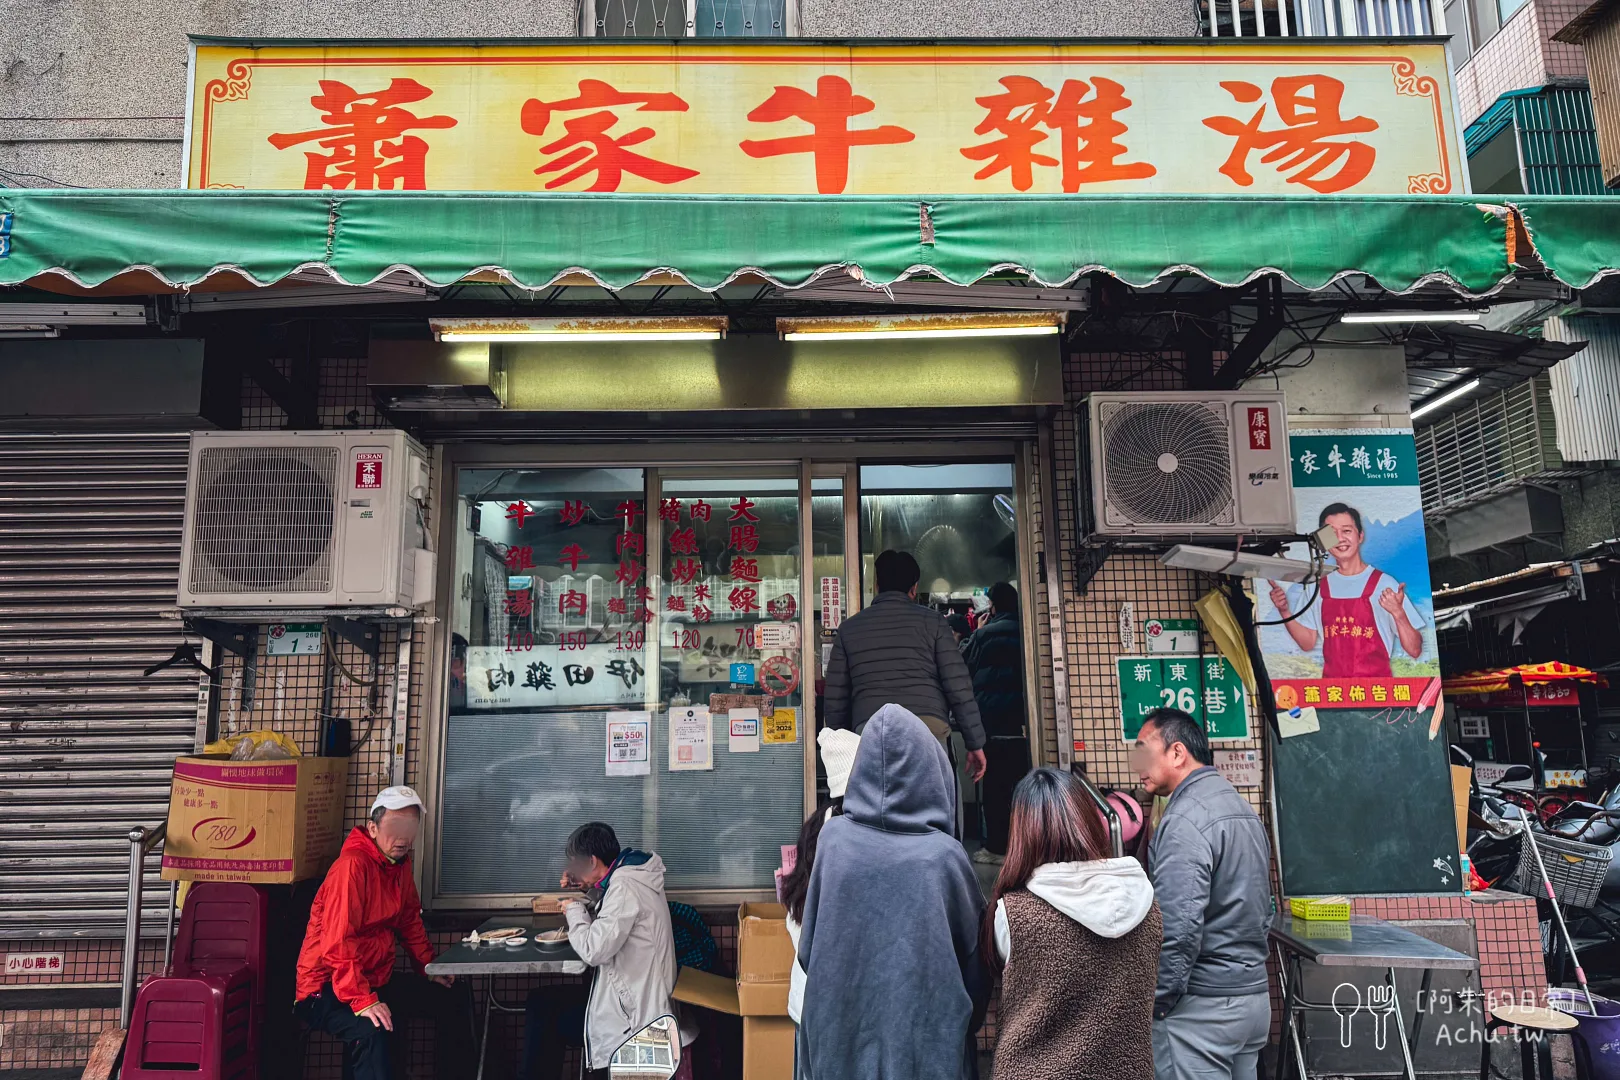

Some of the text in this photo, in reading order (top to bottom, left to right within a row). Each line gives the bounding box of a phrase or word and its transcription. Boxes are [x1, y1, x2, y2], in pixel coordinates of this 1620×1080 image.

[267, 73, 1379, 194] 蕭家牛雜湯
[1252, 411, 1267, 447] 康寶
[1291, 444, 1397, 478] 家牛雜湯
[362, 462, 376, 485] 禾聯
[504, 500, 536, 617] 牛雜湯
[559, 500, 590, 616] 炒牛肉
[728, 496, 762, 613] 大腸麵線
[292, 638, 298, 652] 1
[505, 633, 533, 652] 110
[559, 632, 586, 651] 150
[616, 631, 643, 649] 130
[672, 629, 700, 649] 120
[735, 629, 755, 648] 70
[1170, 637, 1177, 650] 1
[1134, 663, 1225, 682] 新東街
[1304, 685, 1411, 702] 蕭家佈告欄
[207, 826, 237, 841] 780
[195, 872, 250, 881] made in taiwan
[9, 956, 60, 969] 小心階梯
